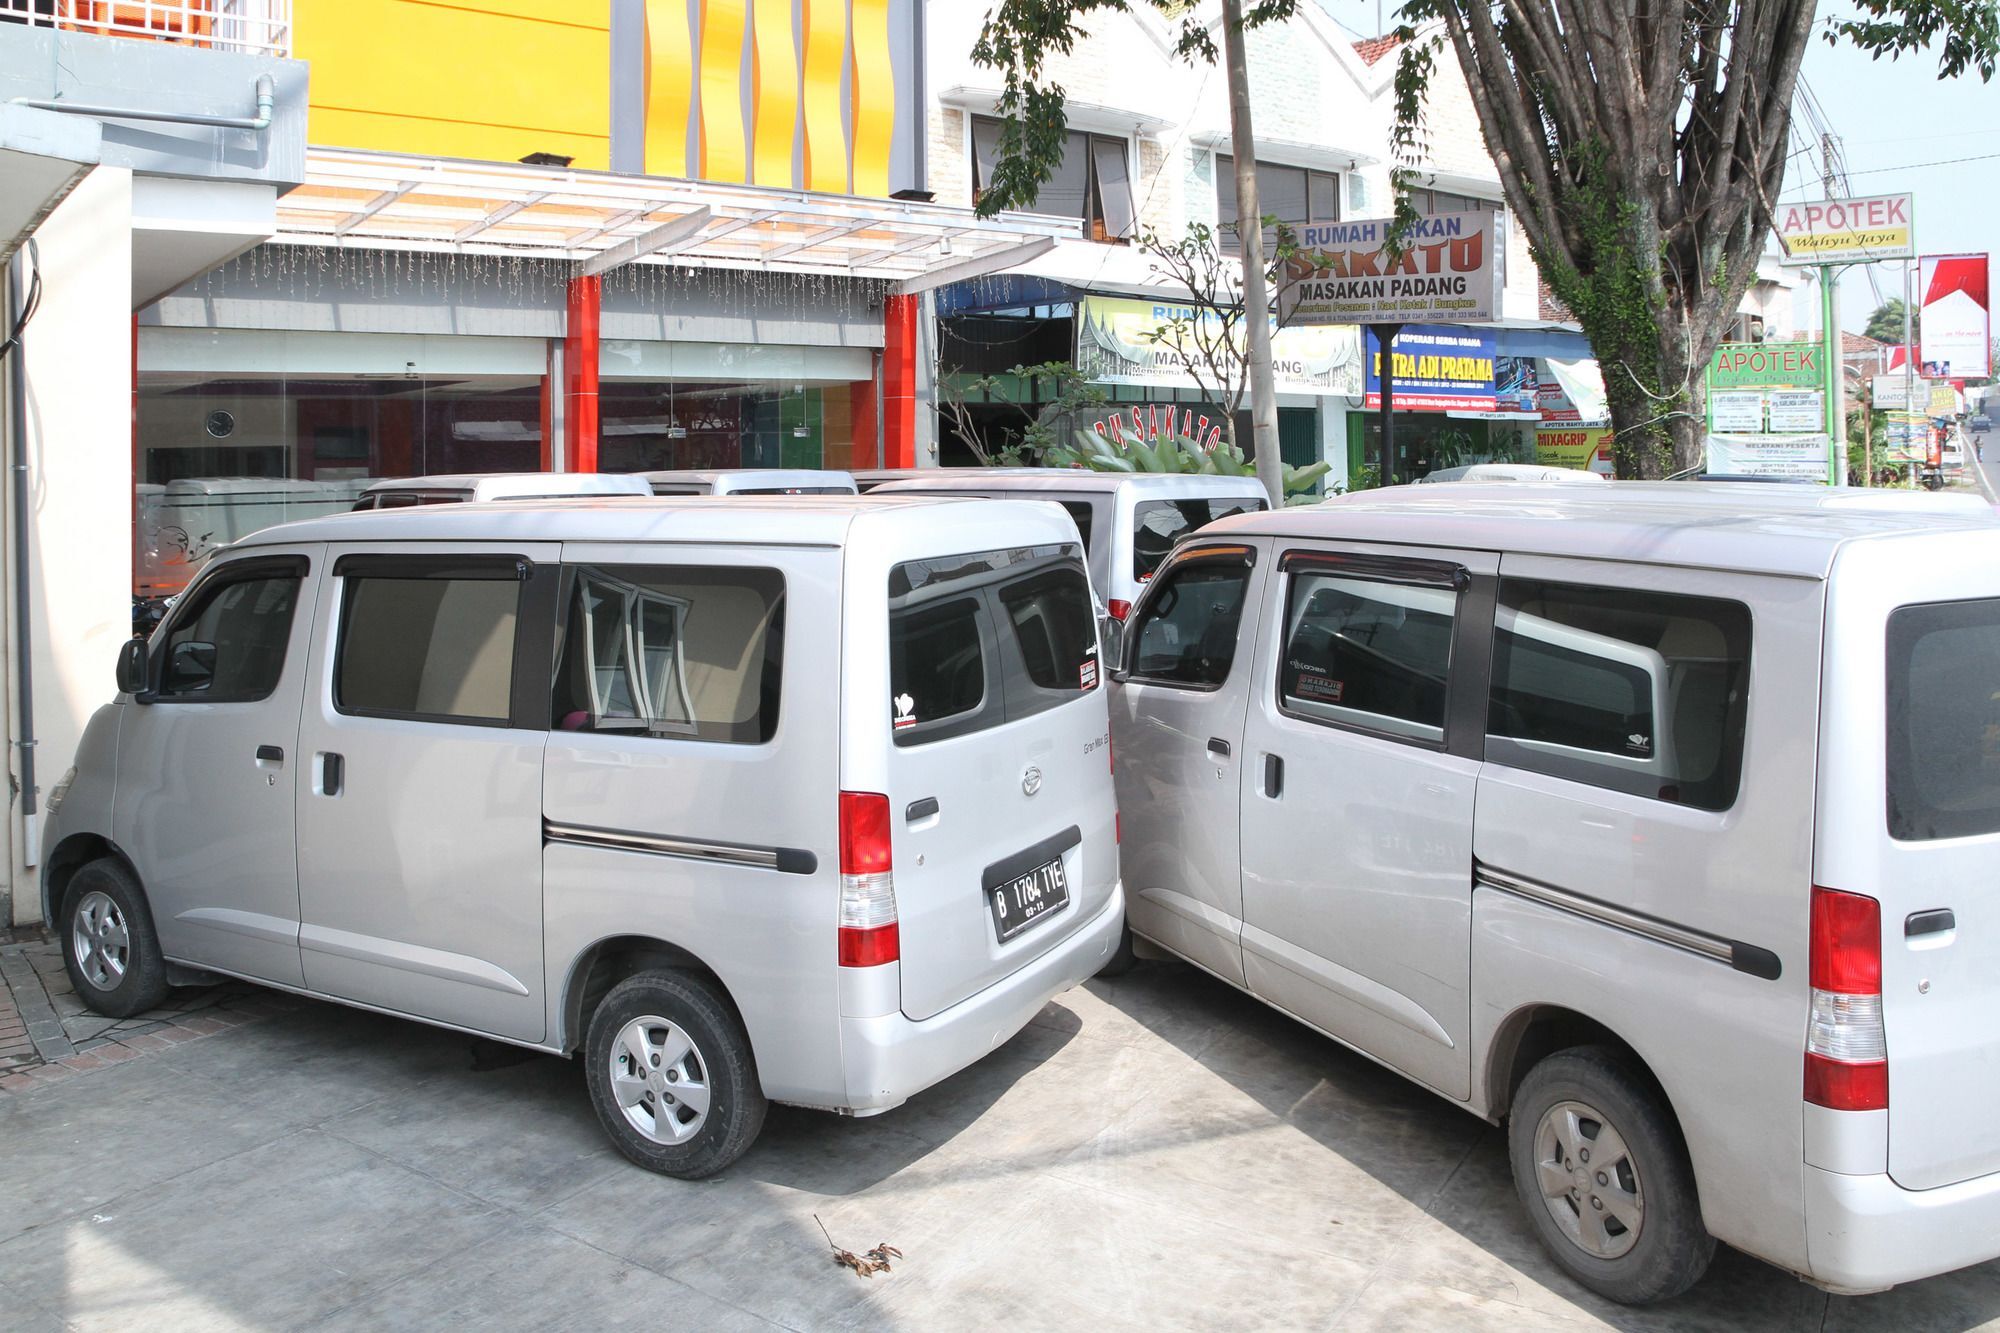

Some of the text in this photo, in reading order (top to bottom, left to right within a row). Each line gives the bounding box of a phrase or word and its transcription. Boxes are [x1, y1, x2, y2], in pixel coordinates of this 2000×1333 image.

[1784, 198, 1907, 232] APOTEK
[1305, 224, 1376, 245] RUMAH
[1794, 232, 1896, 249] Wahyu Jaya
[1288, 229, 1483, 281] SAKATO
[1300, 277, 1467, 300] MASAKAN PADANG
[1400, 299, 1428, 309] Kotak
[1434, 298, 1477, 310] Bungkus
[1400, 334, 1481, 347] KOPERASI SERBA USAHA
[1374, 353, 1494, 381] PTRA ADI PRATAMA
[1717, 350, 1816, 373] APOTEK
[1132, 404, 1221, 457] SAKATO
[1537, 433, 1588, 447] MIXAGRIP
[996, 861, 1063, 918] B 1784 TYE
